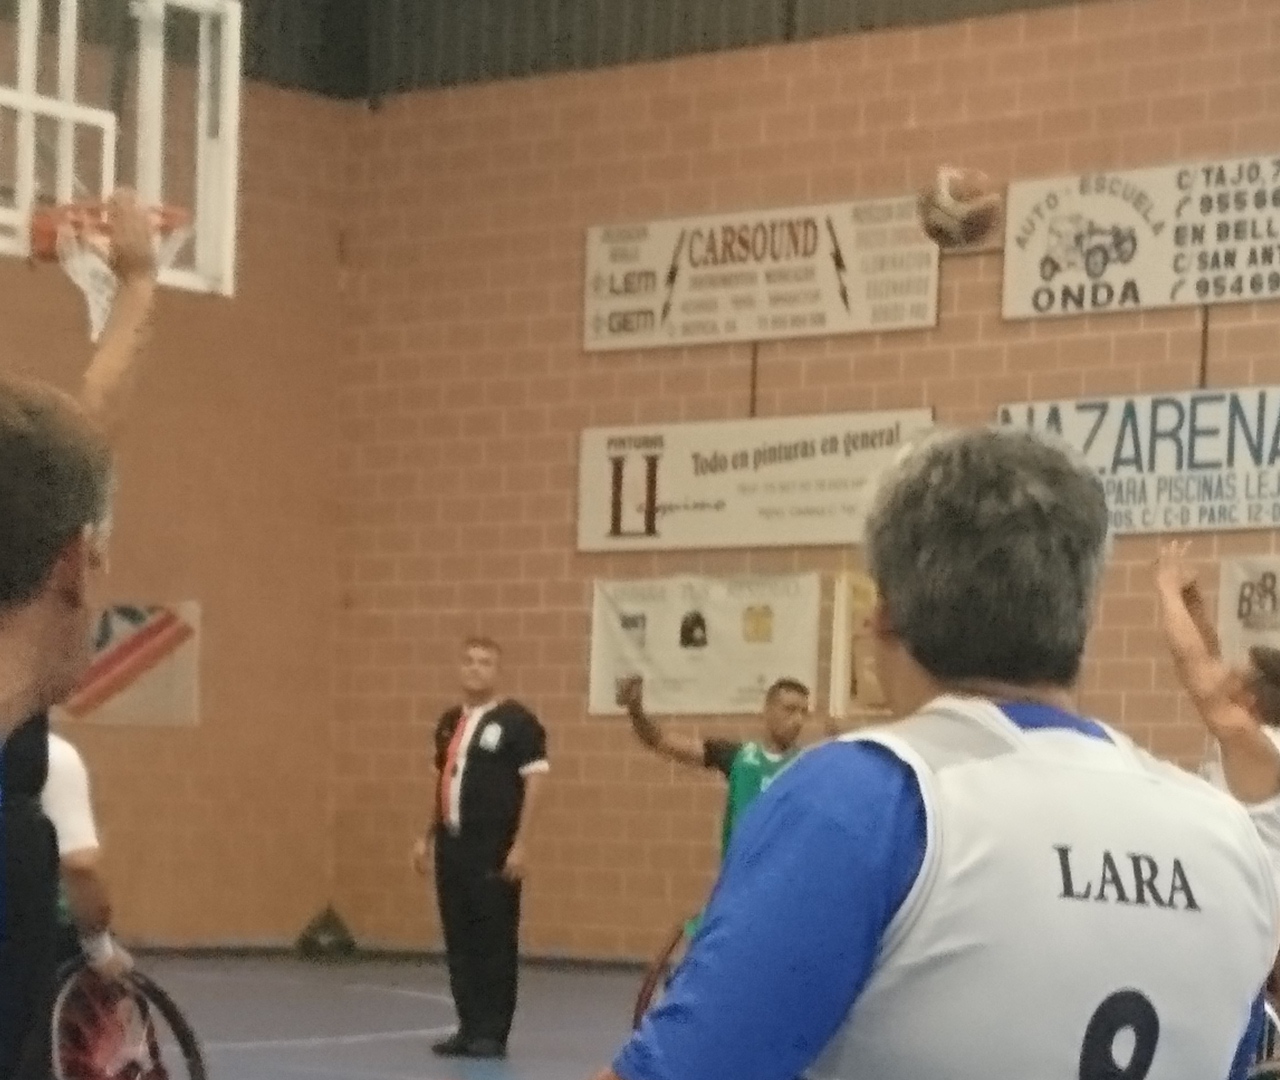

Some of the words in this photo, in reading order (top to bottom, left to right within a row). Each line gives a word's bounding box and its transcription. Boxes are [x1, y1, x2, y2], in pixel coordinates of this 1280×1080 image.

[688, 216, 818, 269] CARSOUND
[1173, 223, 1206, 247] EN
[1196, 248, 1238, 272] SAN
[1032, 278, 1140, 313] ONDA
[691, 450, 728, 477] Todo
[731, 446, 750, 471] en
[753, 436, 817, 473] pinturas
[820, 432, 839, 456] en
[842, 420, 902, 458] general
[1052, 843, 1202, 913] LARA
